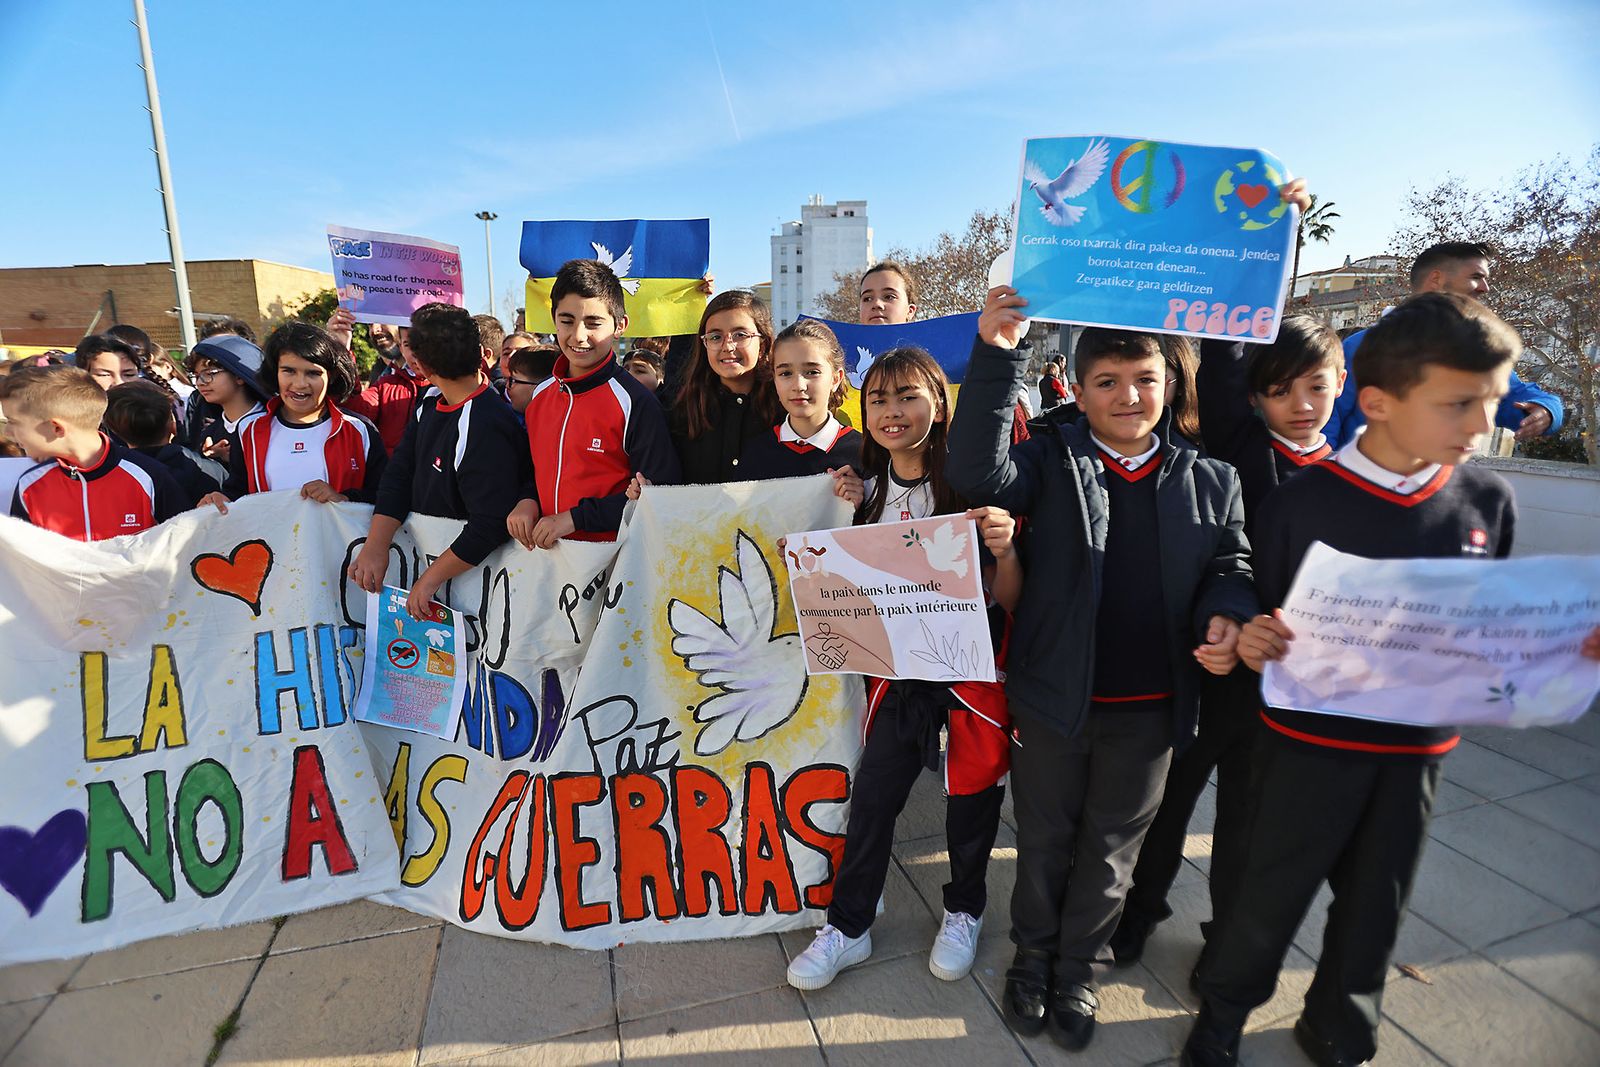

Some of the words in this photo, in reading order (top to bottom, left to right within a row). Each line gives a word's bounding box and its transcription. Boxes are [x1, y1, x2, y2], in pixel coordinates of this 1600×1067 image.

[1022, 235, 1058, 247] Gerrak
[1061, 237, 1081, 247] oso
[1084, 237, 1122, 250] txarrak
[1125, 239, 1146, 251] dira
[1149, 242, 1182, 255] pakea
[1185, 243, 1198, 254] da
[1201, 247, 1238, 259] onena.
[1240, 247, 1281, 262] Jendea
[1088, 255, 1153, 271] borrokatzen
[342, 270, 352, 278] No
[354, 272, 369, 280] has
[371, 274, 392, 283] road
[394, 275, 408, 284] for
[411, 276, 426, 285] the
[1076, 272, 1134, 288] Zergatikez
[1137, 278, 1161, 291] gara
[1163, 280, 1213, 295] gelditzen
[369, 286, 394, 295] peace
[396, 287, 403, 295] is
[406, 288, 420, 296] the
[820, 588, 830, 599] la
[832, 586, 855, 601] paix
[857, 584, 884, 597] dans
[885, 583, 897, 594] le
[899, 580, 942, 594] monde
[1307, 587, 1383, 608] Frieden
[1389, 595, 1441, 615] kann
[800, 606, 852, 617] commence
[854, 605, 872, 619] par
[874, 605, 885, 616] la
[887, 603, 913, 618] paix
[915, 600, 978, 613] intérieure
[1290, 606, 1363, 627] erreicht
[80, 645, 189, 763] LA
[81, 758, 244, 924] NO
[281, 744, 360, 883] A
[384, 741, 469, 888] AS
[459, 761, 851, 931] GUERRAS
